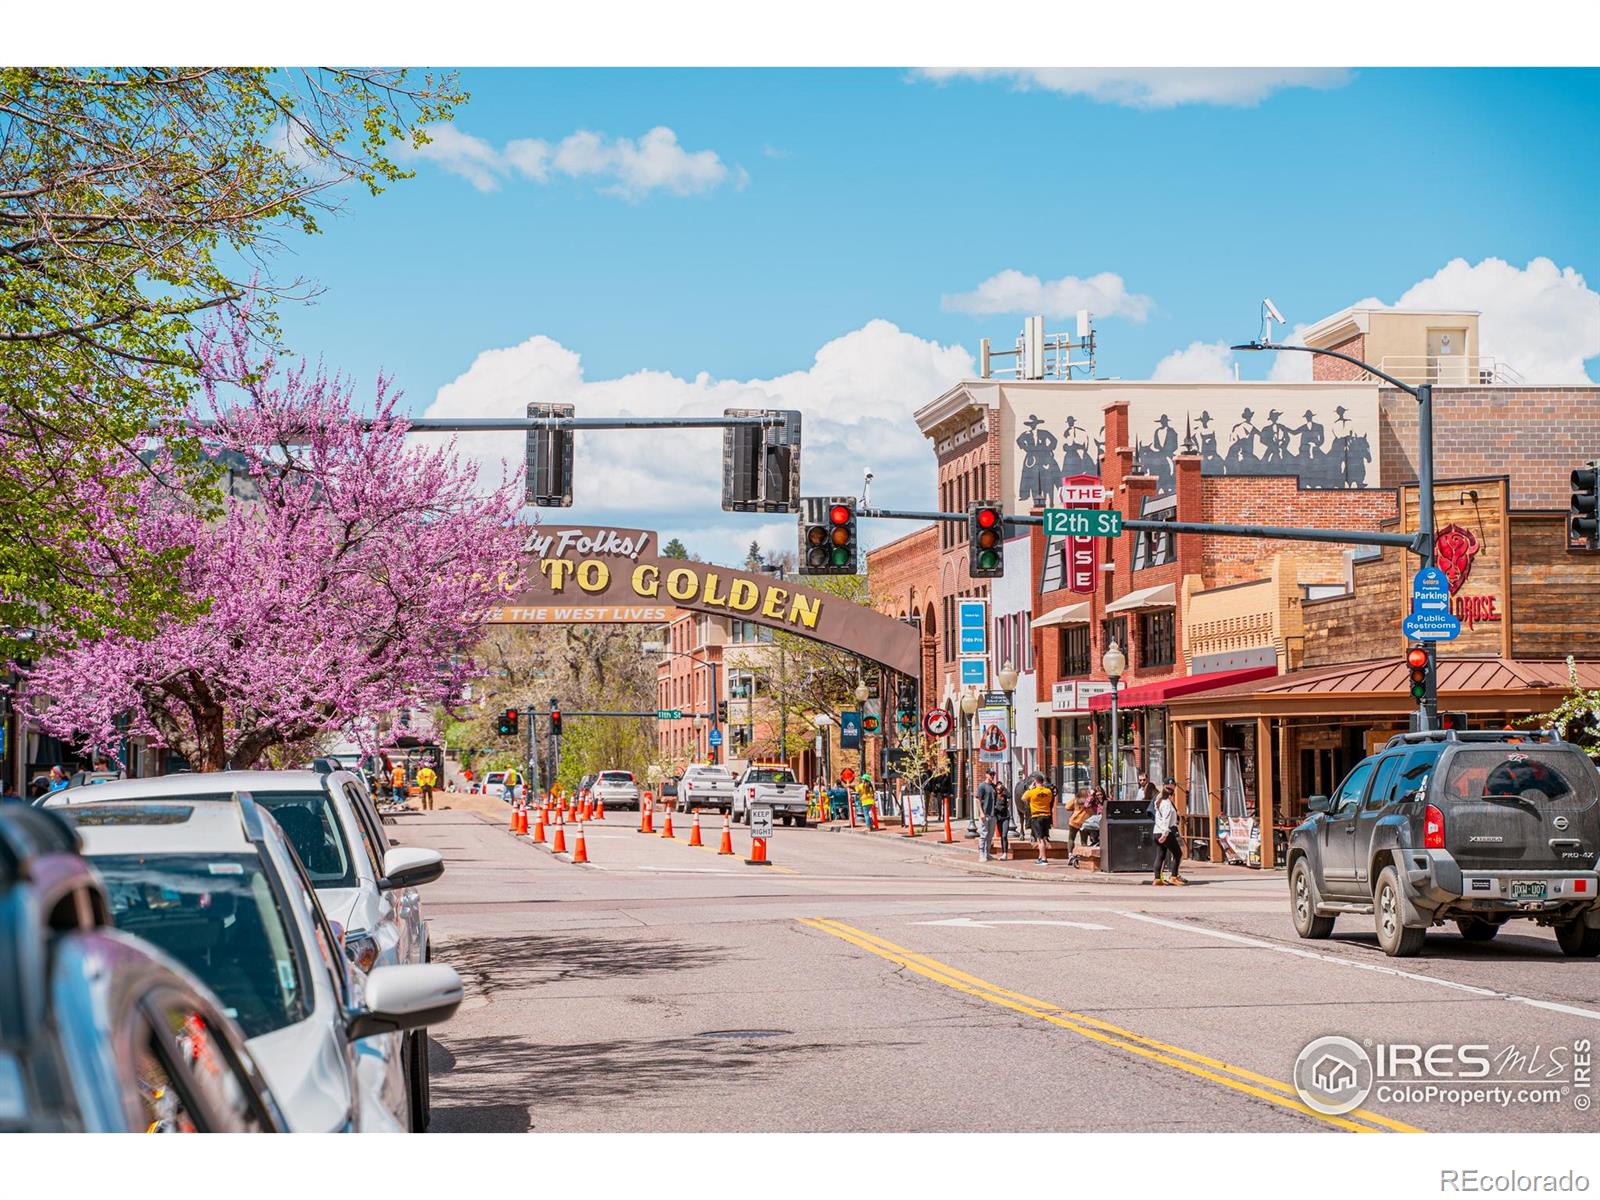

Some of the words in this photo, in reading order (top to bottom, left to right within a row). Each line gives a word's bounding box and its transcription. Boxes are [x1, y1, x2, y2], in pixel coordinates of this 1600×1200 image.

[1066, 488, 1102, 499] THE
[1047, 513, 1089, 532] 12th
[1098, 514, 1118, 533] St
[556, 530, 648, 560] Folks!
[540, 559, 609, 592] TO
[631, 564, 822, 629] GOLDEN
[1415, 591, 1447, 601] Parking
[510, 608, 547, 620] THE
[556, 608, 608, 620] WEST
[612, 608, 666, 620] LIVES
[658, 711, 672, 719] 11th
[673, 711, 680, 719] St
